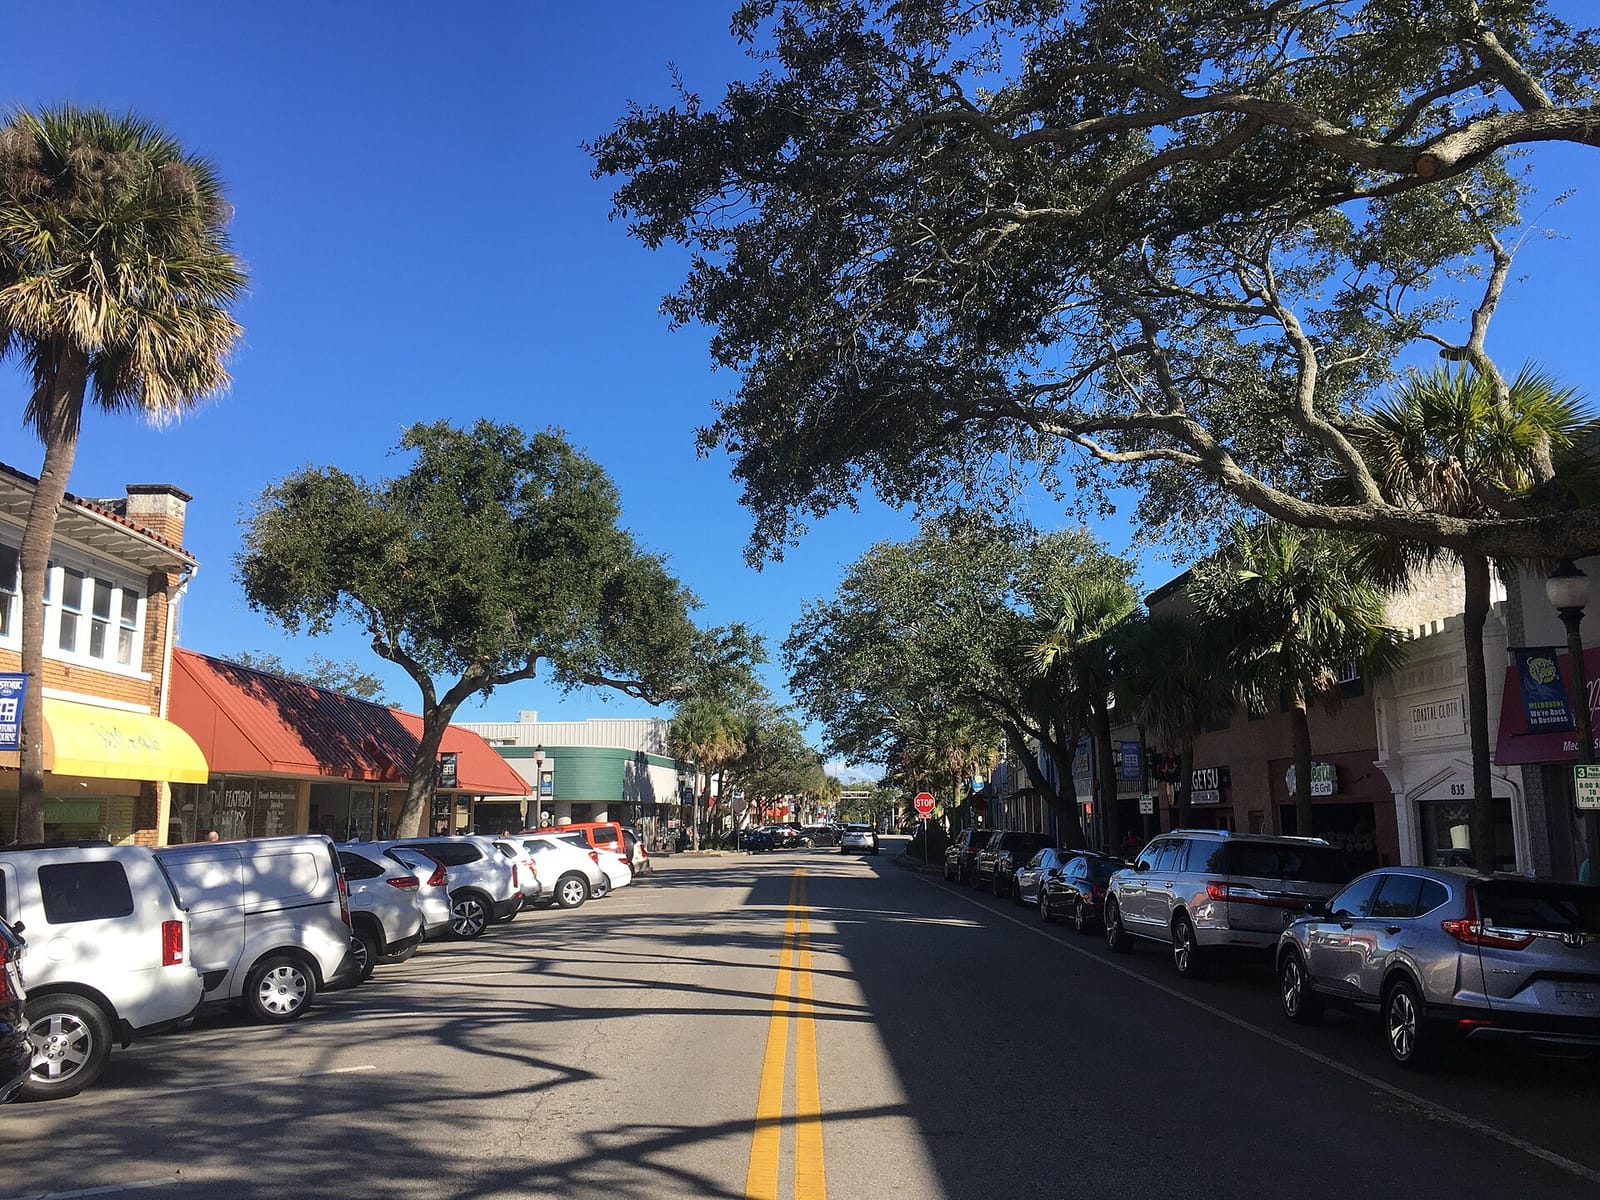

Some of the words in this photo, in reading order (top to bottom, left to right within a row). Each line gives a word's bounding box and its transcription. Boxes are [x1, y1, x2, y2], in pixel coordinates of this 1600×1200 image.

[1413, 706, 1438, 723] COASTAL
[1439, 702, 1458, 719] CLOTH
[1550, 708, 1566, 716] Back
[1538, 716, 1569, 724] Business
[1578, 768, 1586, 778] 3
[1191, 768, 1219, 790] GETSU
[1451, 784, 1465, 796] 835
[225, 790, 252, 808] FEATHERS
[916, 799, 934, 807] STOP
